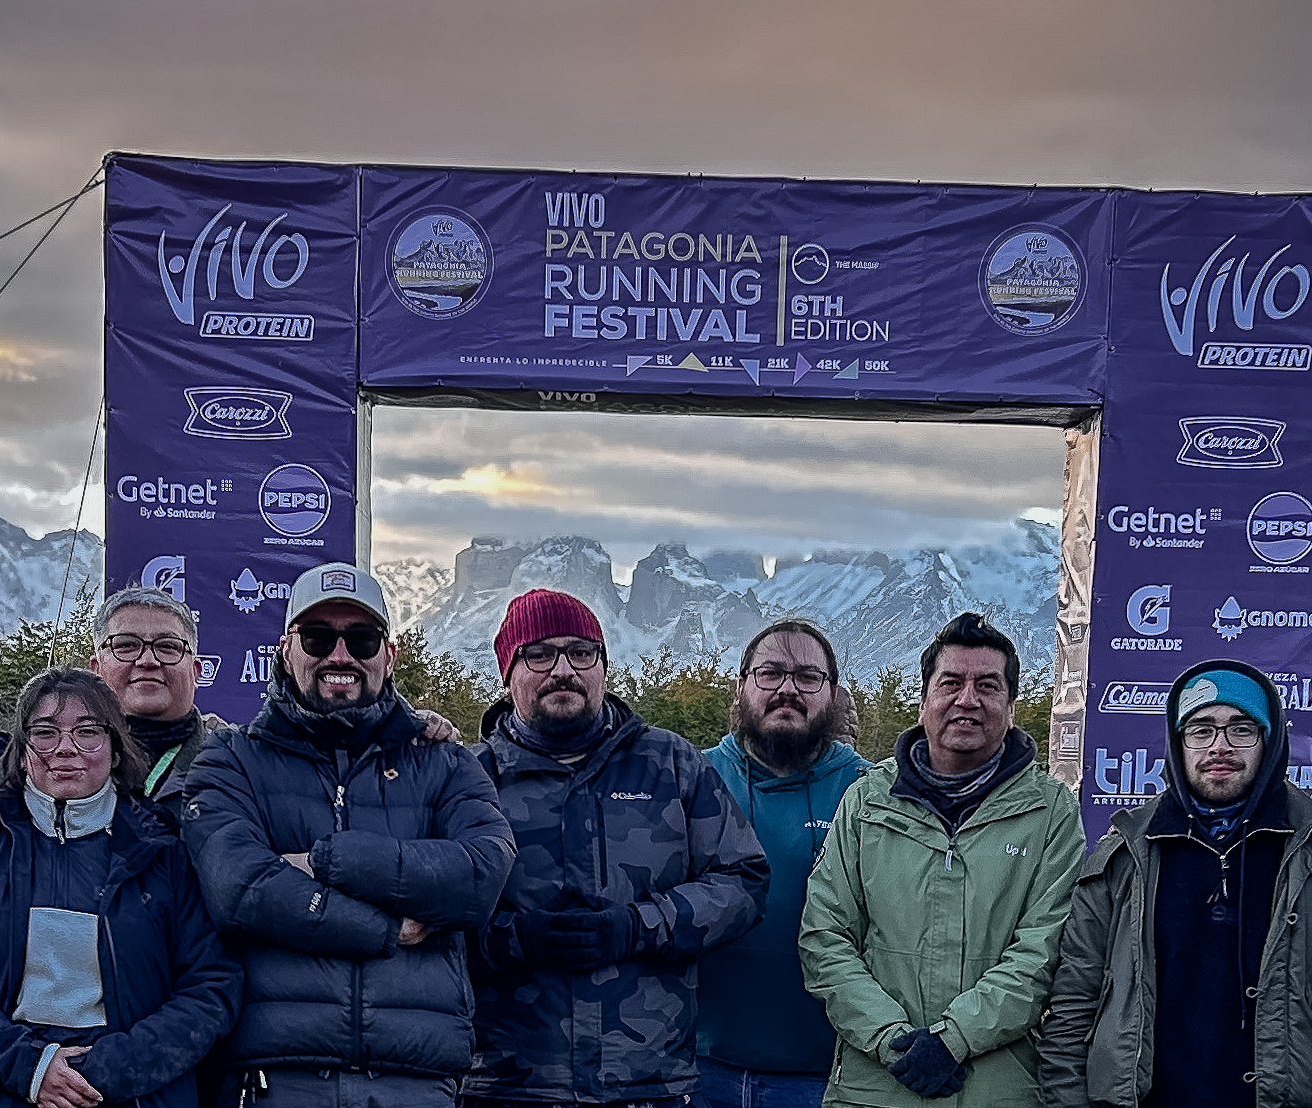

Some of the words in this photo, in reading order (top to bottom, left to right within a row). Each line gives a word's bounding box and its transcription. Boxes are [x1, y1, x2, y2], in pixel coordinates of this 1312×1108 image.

[545, 192, 605, 228] VIVO
[546, 229, 763, 263] PATAGONIA
[544, 263, 762, 305] RUNNING
[791, 294, 843, 317] 6TH
[205, 315, 310, 337] PROTEIN
[544, 304, 761, 343] FESTIVAL
[791, 318, 889, 341] EDITION
[516, 357, 529, 365] LO
[656, 354, 673, 366] 5K
[710, 356, 733, 367] 11K
[767, 358, 789, 369] 21K
[815, 359, 841, 370] 42K
[864, 360, 889, 371] 50K
[1203, 346, 1307, 367] PROTEIN
[538, 391, 596, 403] VIVO
[204, 403, 270, 421] Carozzi
[1197, 432, 1264, 450] Carozzi
[117, 475, 218, 505] Getnet
[264, 492, 326, 510] PEPSI
[140, 506, 152, 519] By
[167, 507, 216, 520] Santander
[1107, 505, 1207, 534] Getnet
[1129, 536, 1141, 549] By
[1155, 537, 1204, 549] Santander
[1110, 638, 1182, 651] GATORADE
[1108, 685, 1168, 706] Colema
[1095, 749, 1167, 794] tik
